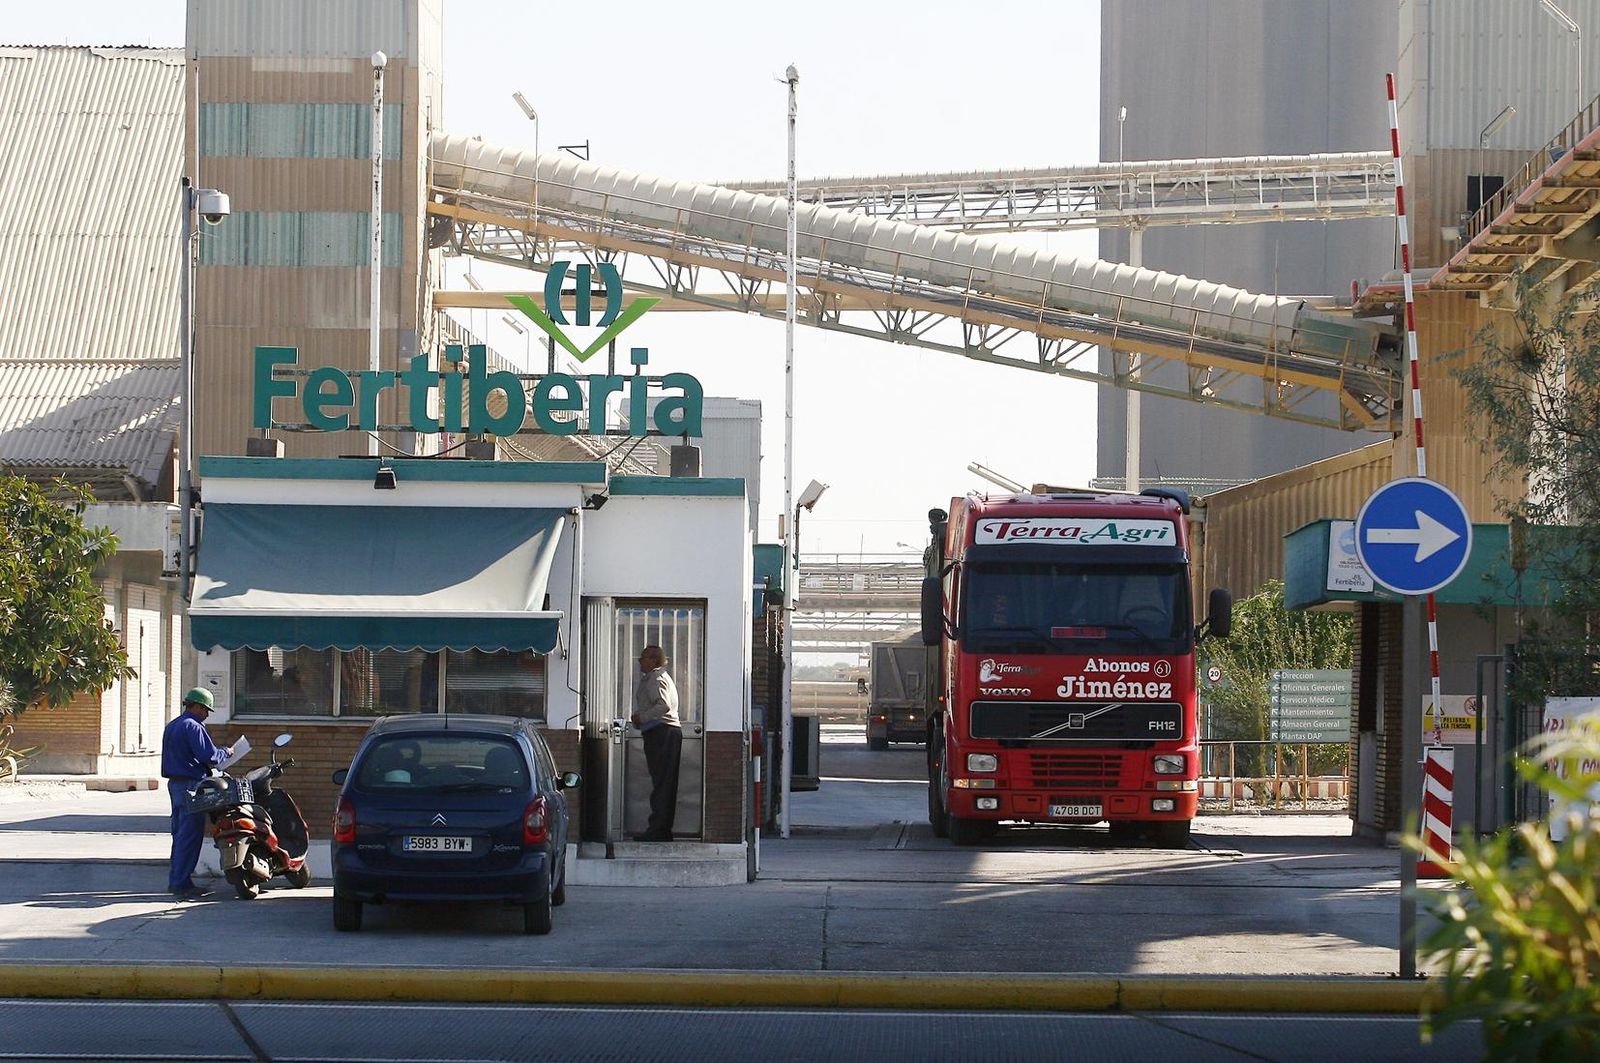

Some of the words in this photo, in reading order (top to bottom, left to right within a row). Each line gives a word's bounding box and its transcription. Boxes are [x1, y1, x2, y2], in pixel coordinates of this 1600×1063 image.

[252, 344, 704, 437] Fertiberia
[1083, 658, 1150, 673] Abonos
[1056, 674, 1172, 699] Jiménez
[1281, 684, 1310, 692] Oficinas
[1311, 683, 1345, 692] Generales
[979, 687, 1032, 696] VOLVO
[1281, 696, 1308, 704] Servicio
[1281, 708, 1334, 716] Mantenimiento
[1148, 721, 1175, 730] FH12
[1312, 720, 1340, 728] General
[1281, 732, 1306, 740] Plantas
[1307, 732, 1322, 740] DAP
[1055, 806, 1080, 816] 4708
[1082, 806, 1101, 816] DCT
[410, 837, 439, 850] 5983
[444, 838, 466, 850] BYW
